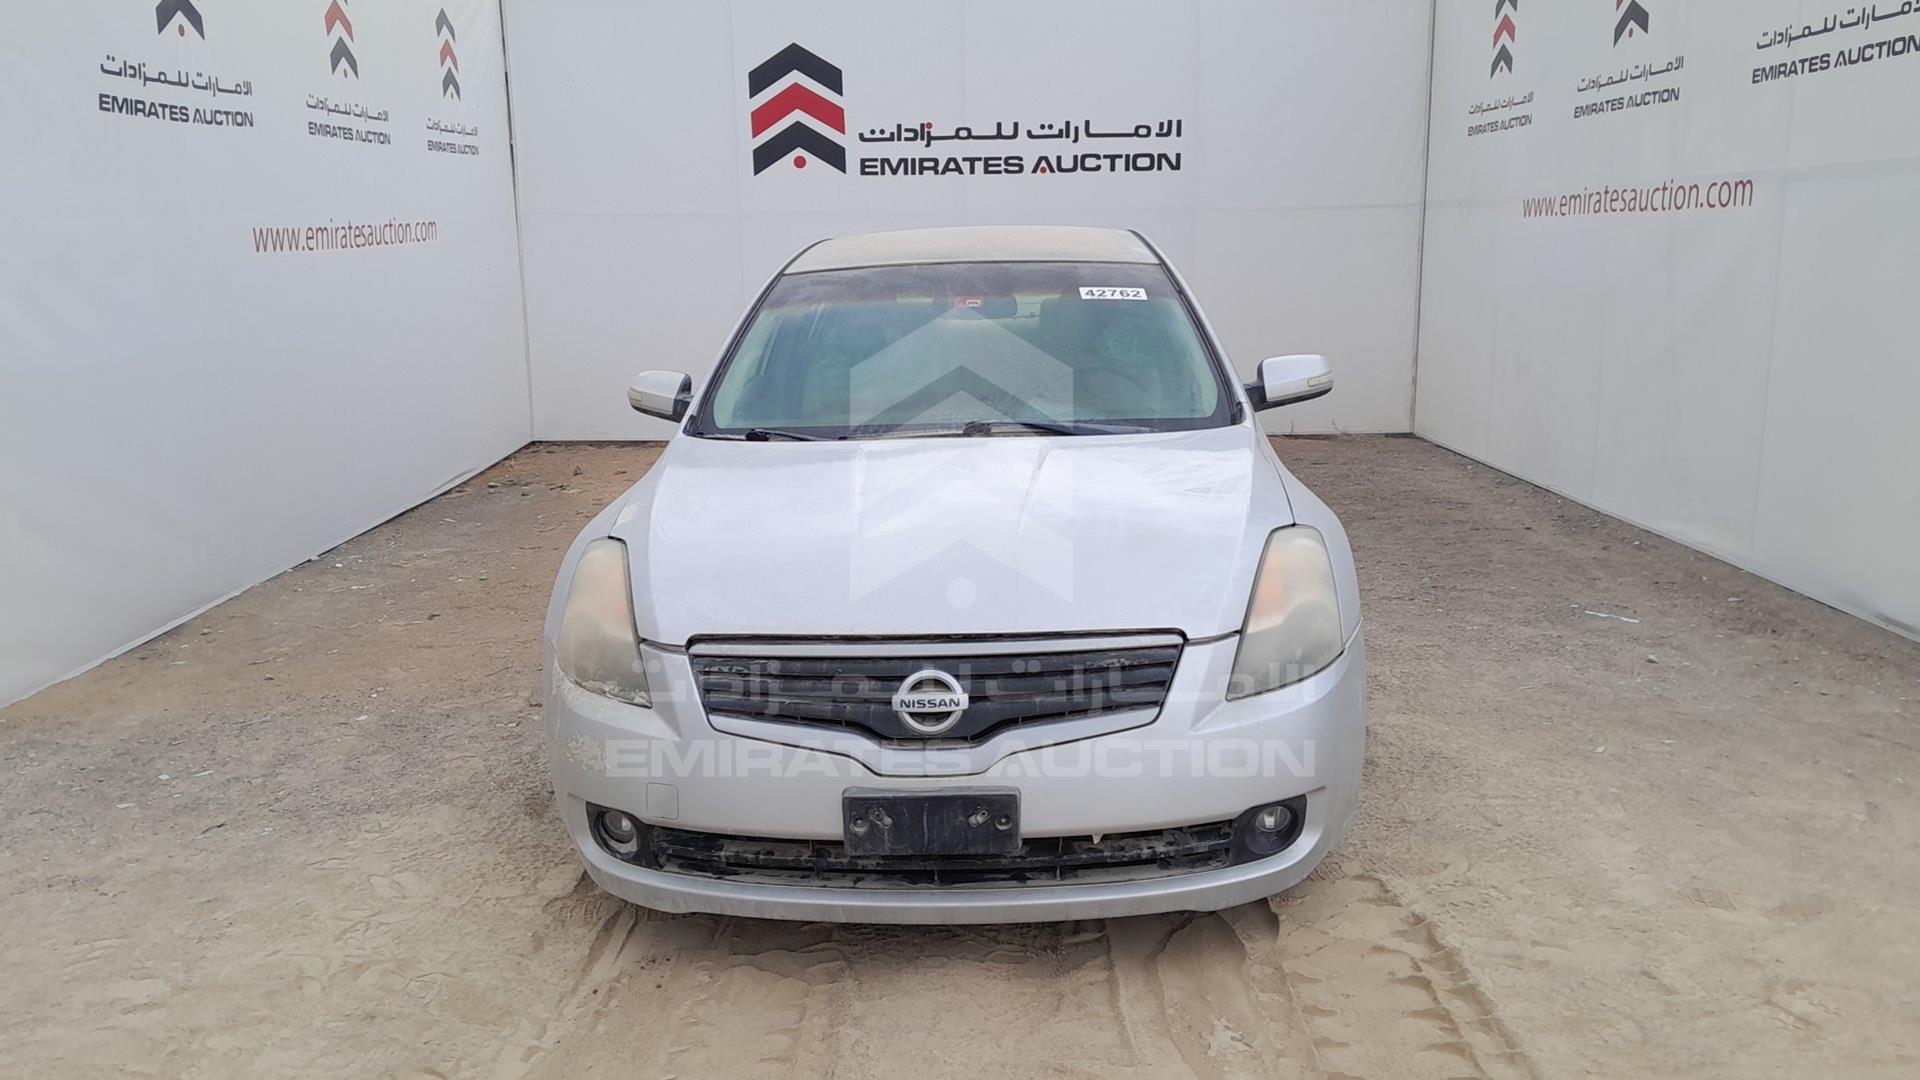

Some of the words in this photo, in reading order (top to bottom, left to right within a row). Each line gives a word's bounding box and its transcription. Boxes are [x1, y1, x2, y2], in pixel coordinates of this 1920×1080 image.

[1752, 53, 1830, 84] EMIRATES
[1834, 35, 1920, 68] AUCTION
[98, 93, 189, 123] EMIRATES
[193, 108, 254, 127] AUCTION
[1573, 96, 1625, 118] EMIRATES
[1626, 87, 1680, 108] AUCTION
[308, 121, 354, 141] EMIRATES
[355, 128, 391, 145] AUCTION
[858, 121, 1019, 147] للمزادات
[1467, 120, 1499, 136] EMIRATES
[1500, 114, 1532, 130] AUCTION
[427, 139, 456, 154] EMIRATES
[457, 143, 480, 155] AUCTION
[860, 155, 1024, 176] EMIRATES
[1031, 152, 1182, 174] AUCTION
[1522, 178, 1754, 219] www.emiratesauction.com
[253, 217, 438, 253] www.emiratesauction.com
[1085, 288, 1143, 298] 42762
[900, 697, 960, 709] NISSAN
